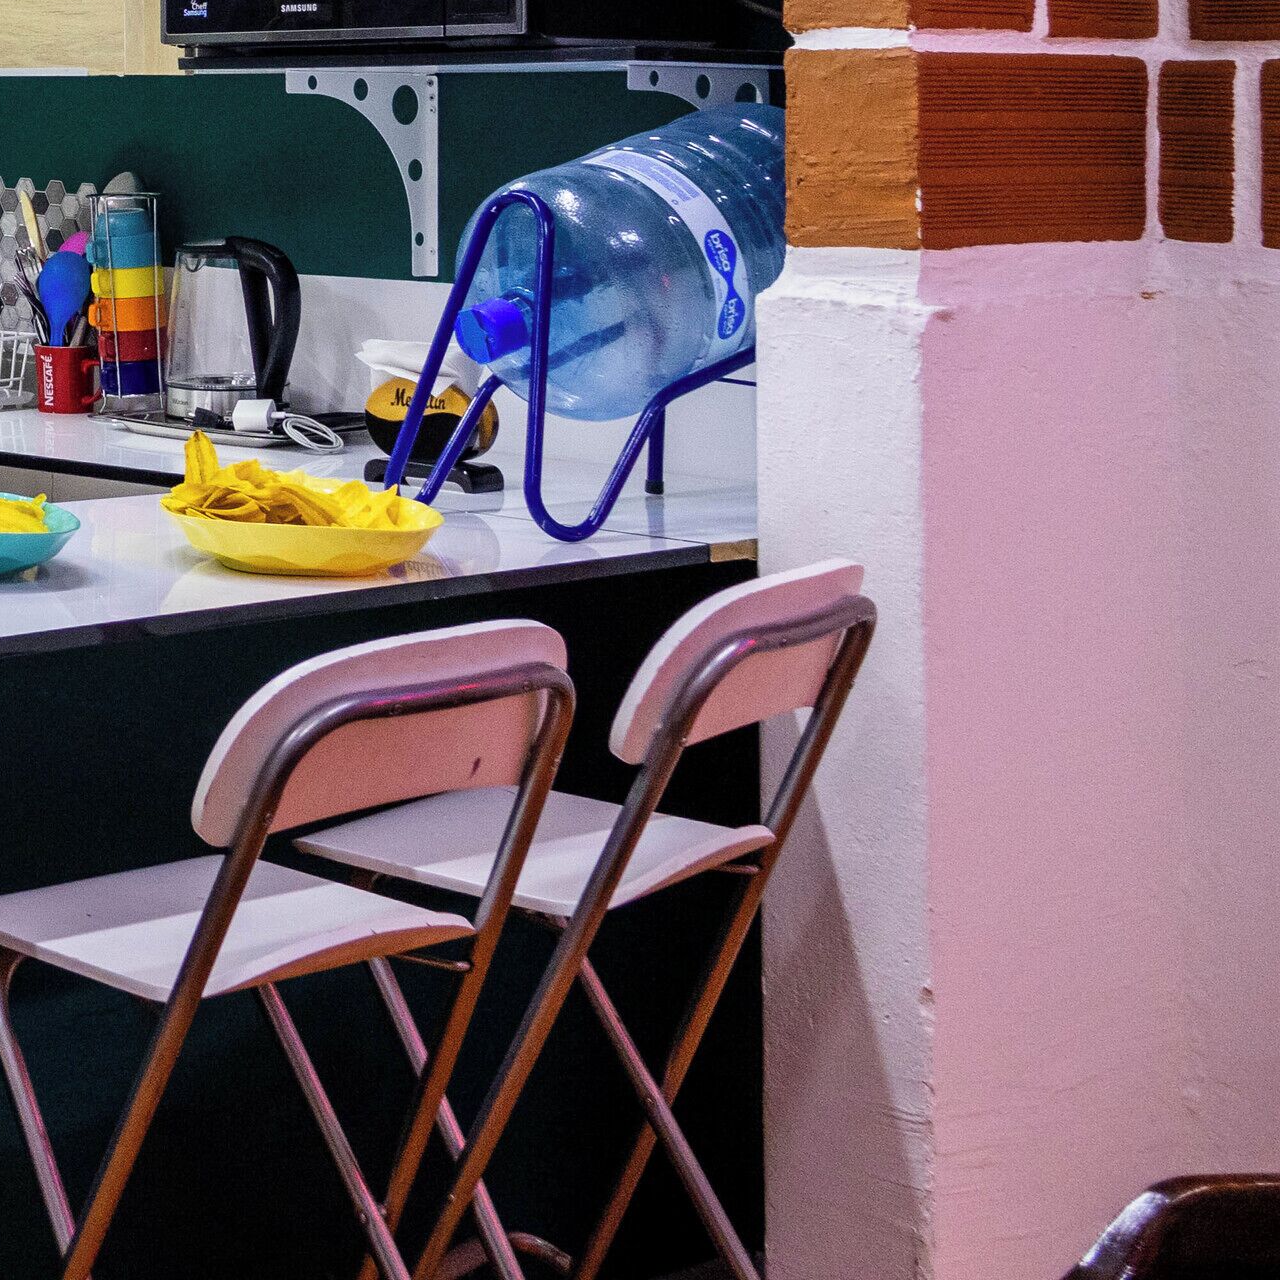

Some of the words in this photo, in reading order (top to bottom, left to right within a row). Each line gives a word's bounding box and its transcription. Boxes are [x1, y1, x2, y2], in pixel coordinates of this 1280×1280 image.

[280, 3, 318, 13] SAMSUNG
[183, 9, 207, 18] Samsung
[710, 233, 731, 272] brisa
